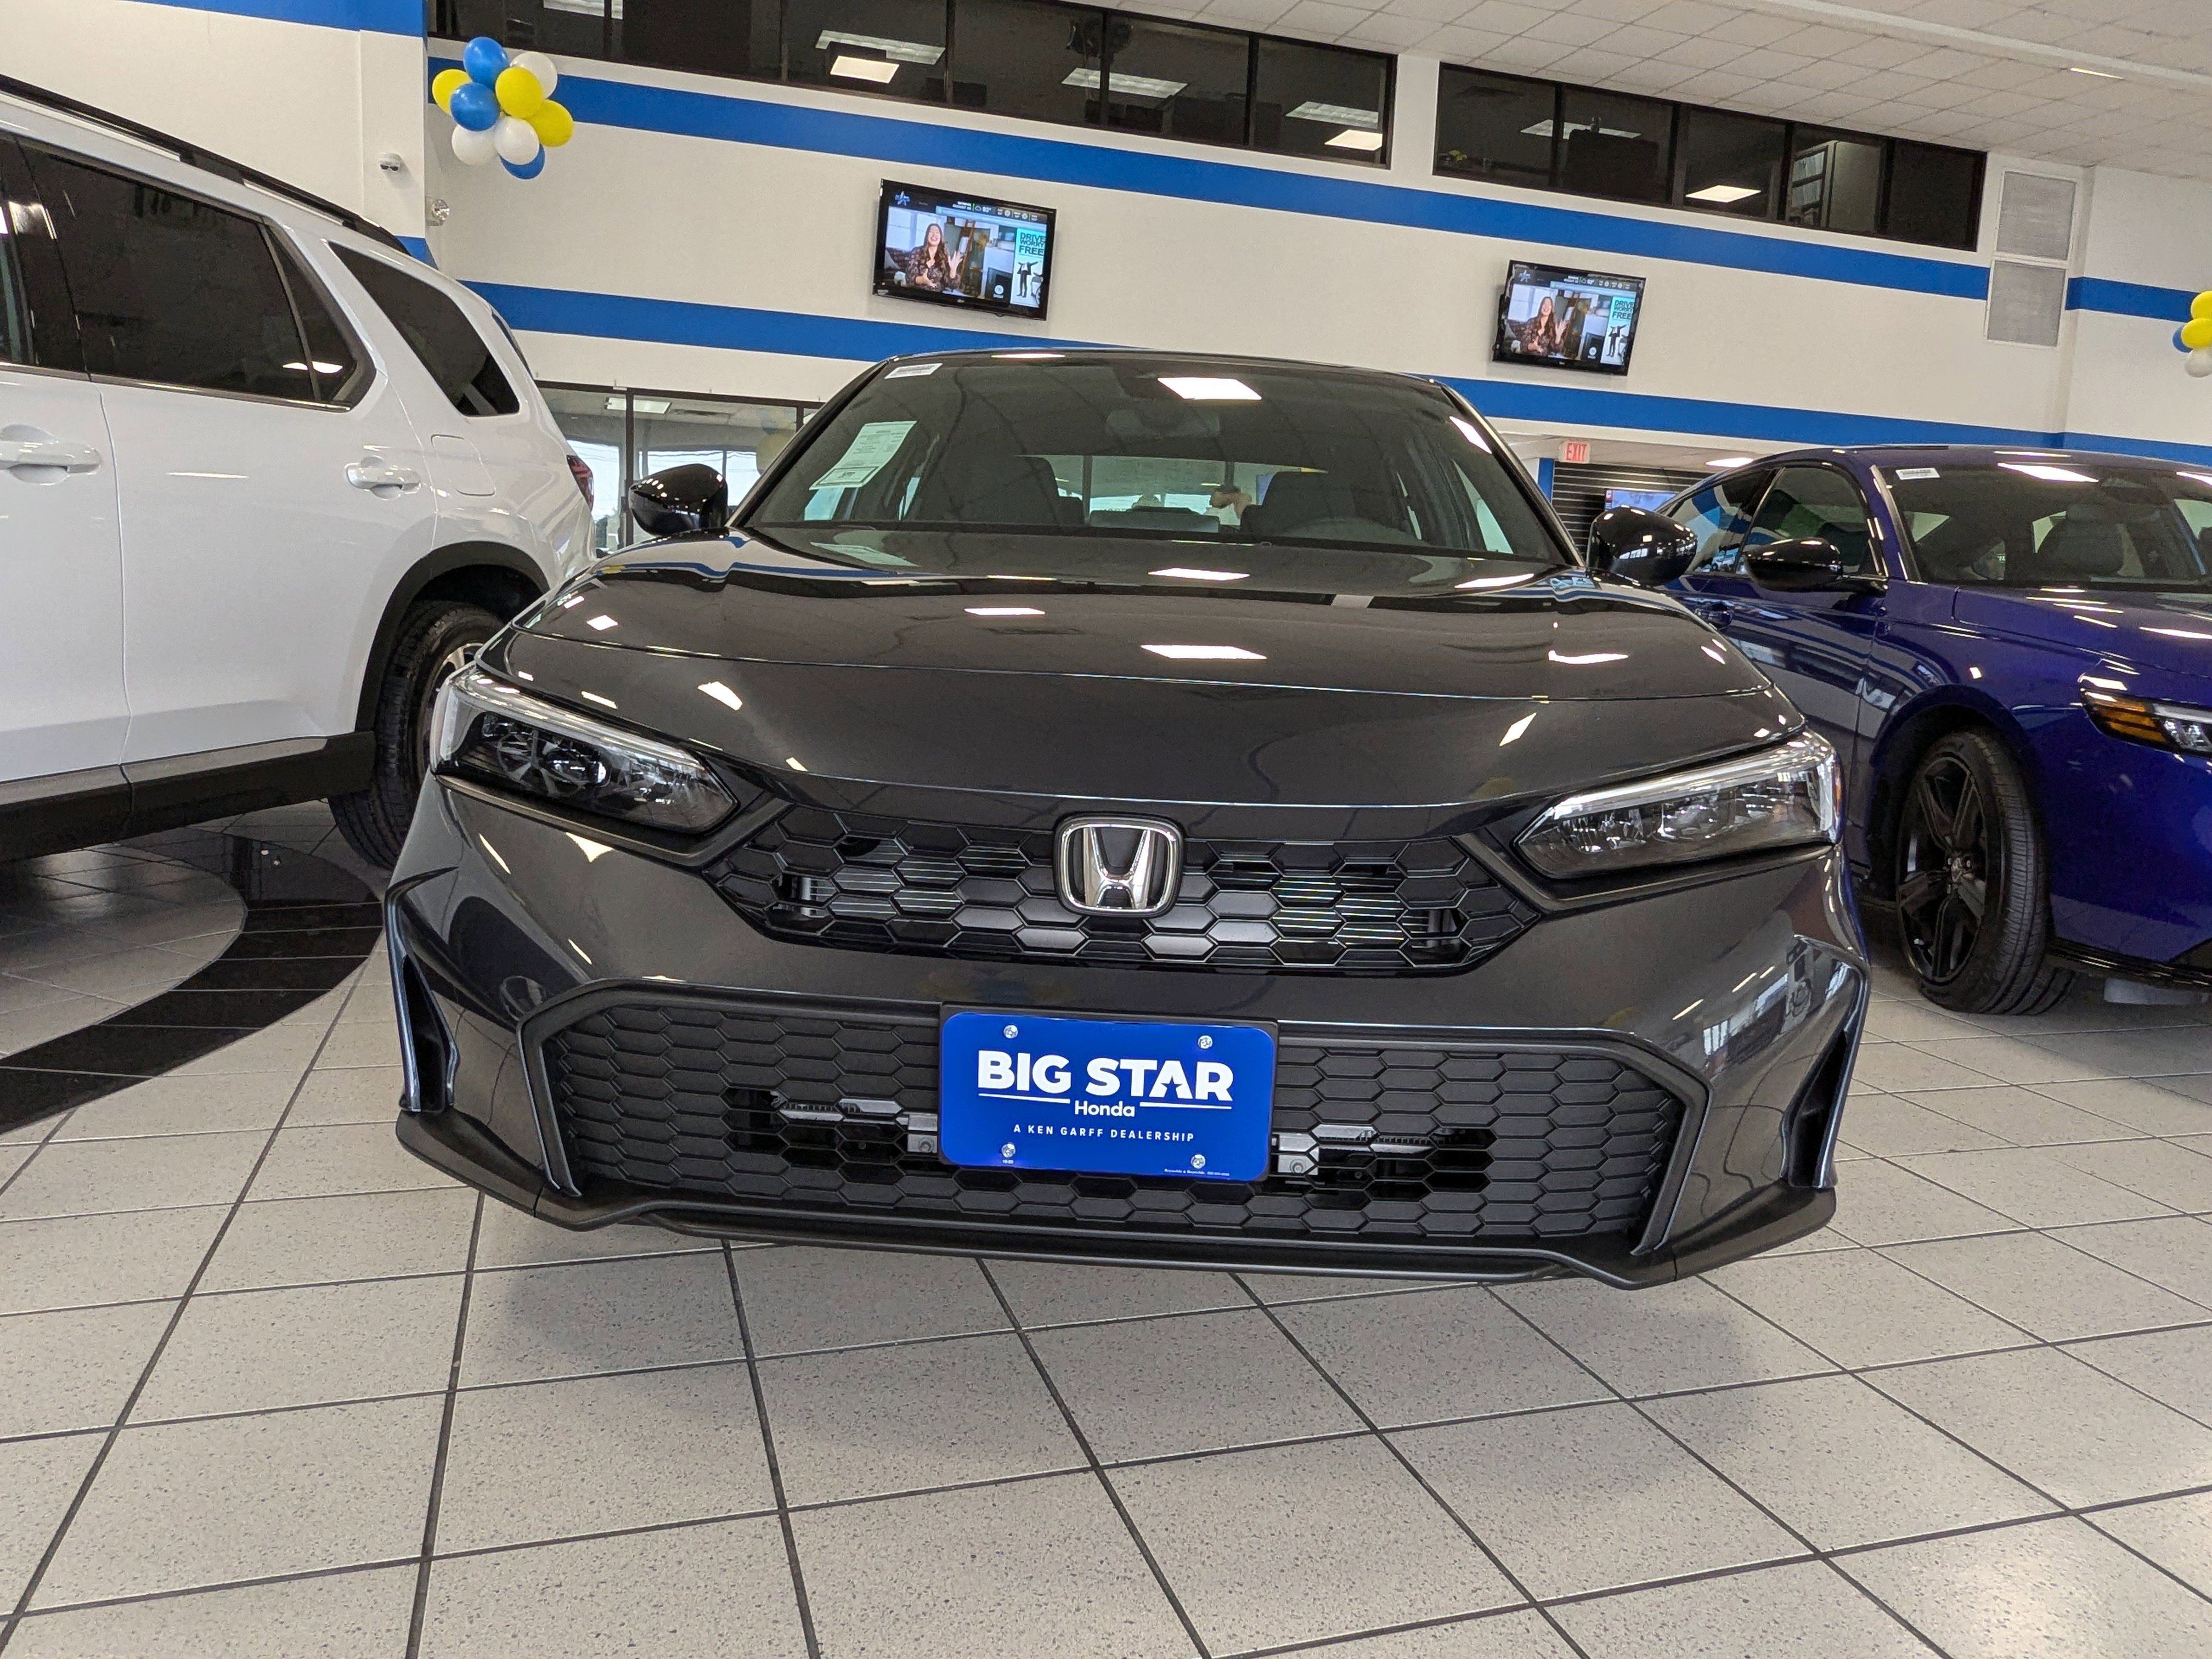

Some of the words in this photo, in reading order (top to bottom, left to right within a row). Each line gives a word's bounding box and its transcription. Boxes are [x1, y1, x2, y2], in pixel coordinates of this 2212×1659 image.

[1020, 232, 1046, 242] DRIVE
[1020, 239, 1045, 248] WORRY
[1019, 245, 1043, 256] FREE
[1615, 300, 1634, 308] DRIVE
[1612, 311, 1632, 320] FREE
[1566, 443, 1587, 461] EXIT
[978, 1050, 1071, 1094] BIG
[1085, 1057, 1233, 1102] STAR
[1075, 1100, 1135, 1117] Honda
[1013, 1124, 1021, 1133] A
[1028, 1125, 1053, 1135] KEN
[1060, 1127, 1103, 1137] GARFF
[1110, 1129, 1194, 1142] DEALERSHIP
